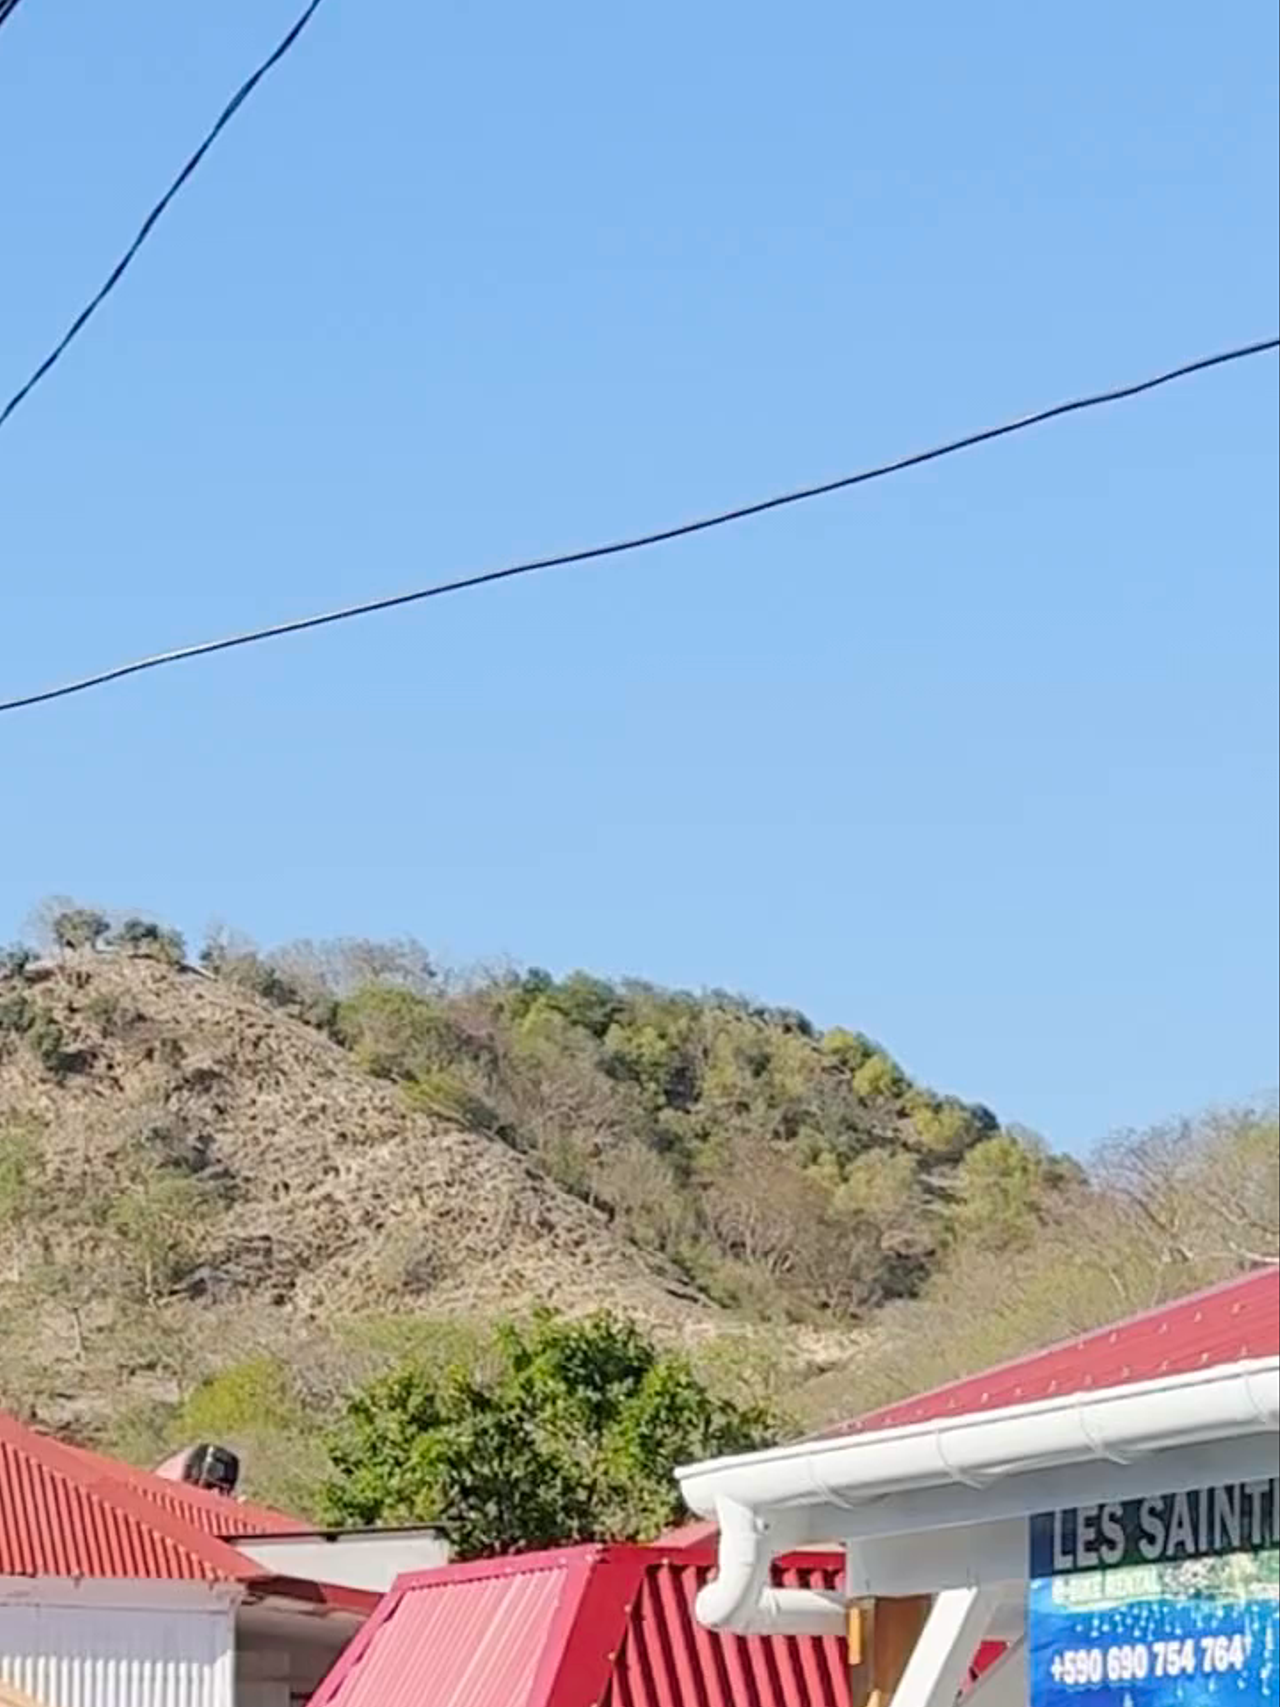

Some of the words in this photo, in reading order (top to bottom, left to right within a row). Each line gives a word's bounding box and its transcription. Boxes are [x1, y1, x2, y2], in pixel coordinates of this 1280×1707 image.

[1054, 1502, 1126, 1571] LES
[1051, 1648, 1103, 1685] +590
[1107, 1643, 1149, 1681] 690
[1152, 1638, 1196, 1677] 754
[1200, 1634, 1245, 1673] 764
